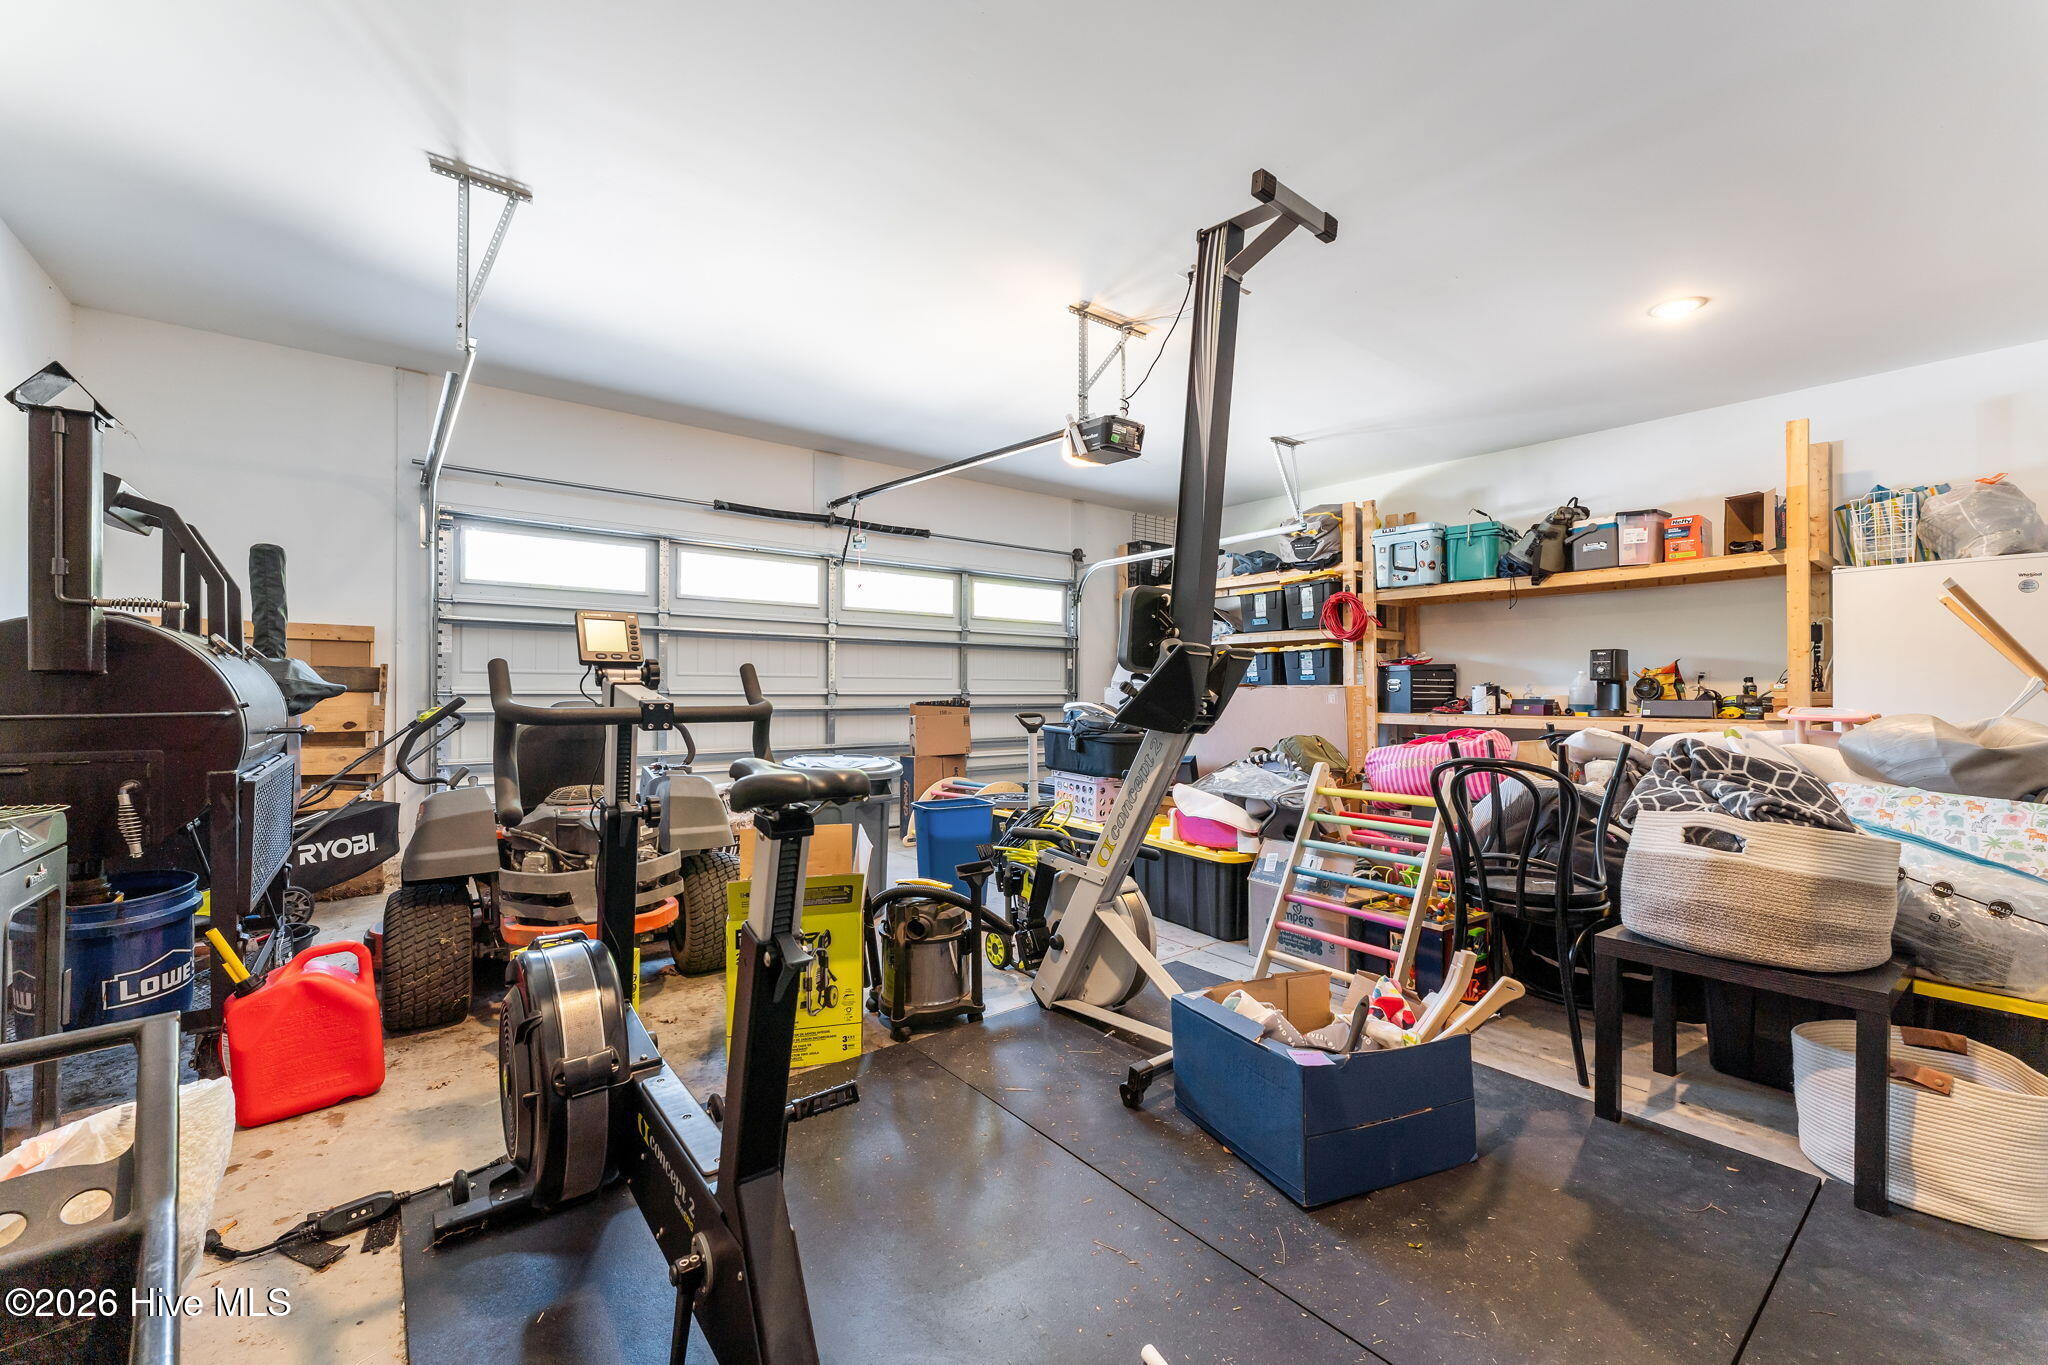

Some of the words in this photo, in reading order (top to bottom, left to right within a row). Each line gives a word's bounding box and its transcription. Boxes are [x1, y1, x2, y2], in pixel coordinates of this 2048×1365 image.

[1111, 754, 1155, 841] concept
[1150, 737, 1163, 753] 2
[297, 832, 376, 866] RYOBI
[1990, 905, 2011, 914] STOP
[649, 1135, 686, 1204] concept
[688, 1196, 695, 1219] 2
